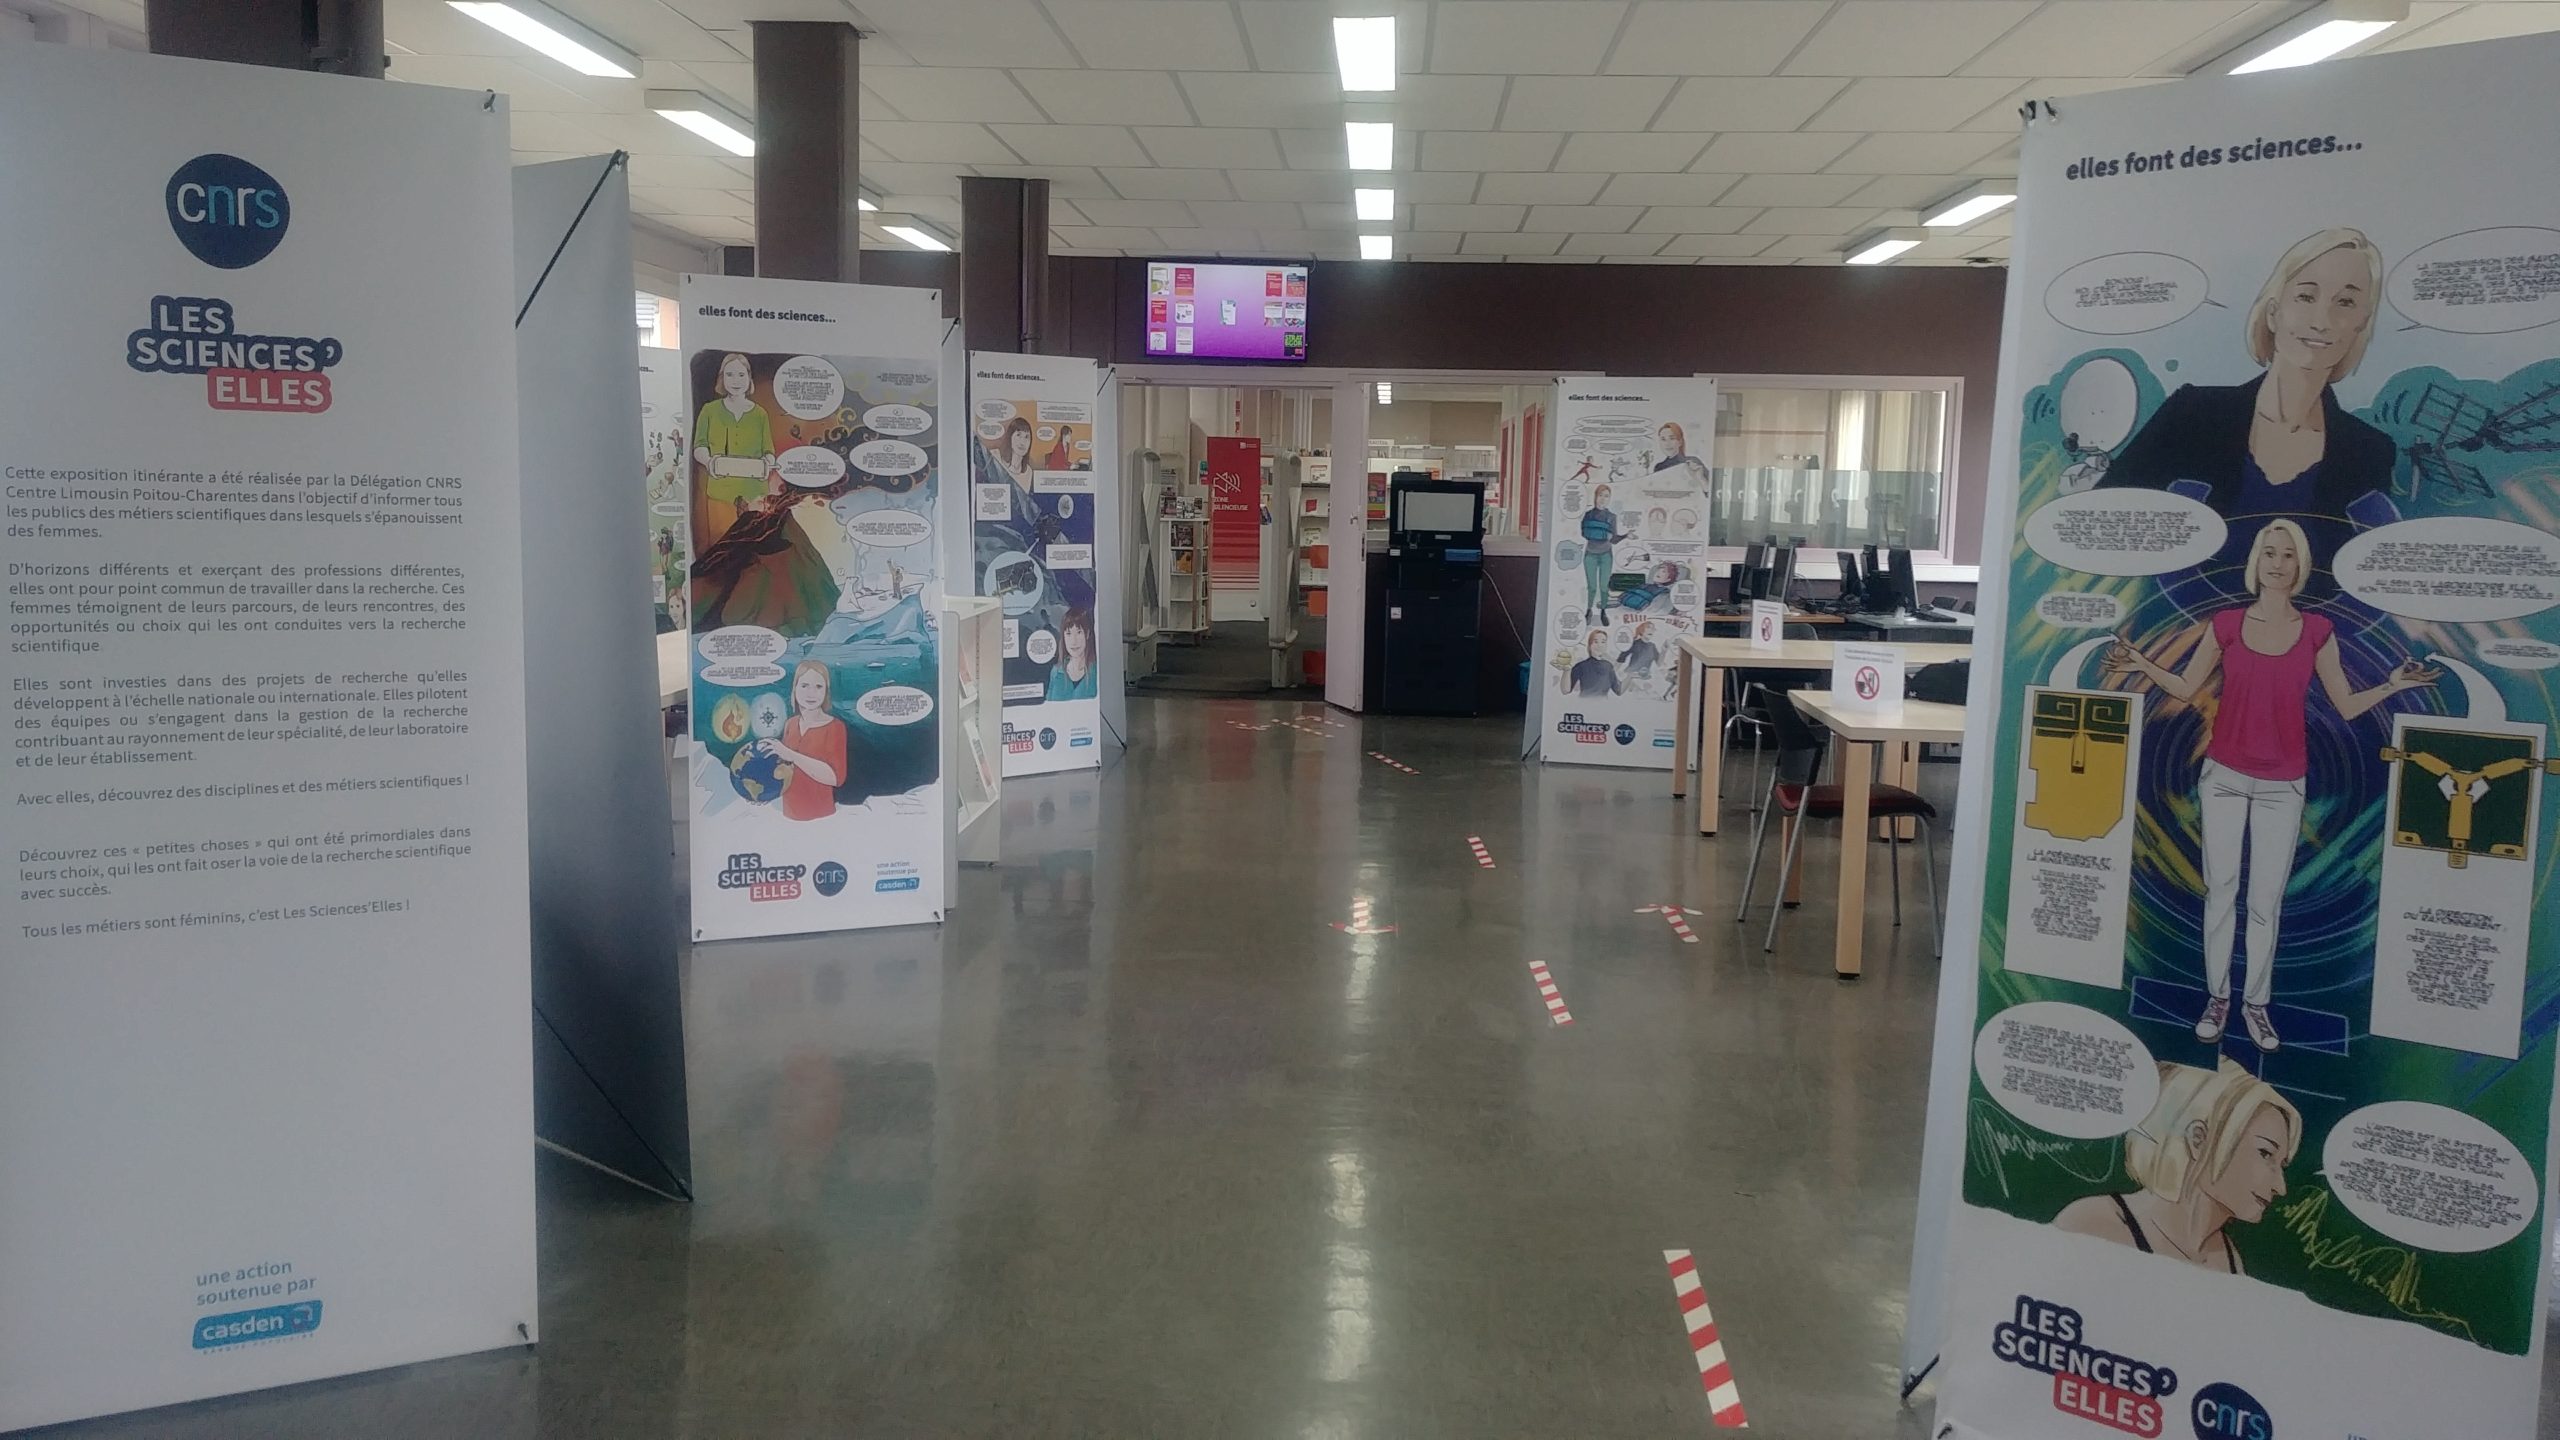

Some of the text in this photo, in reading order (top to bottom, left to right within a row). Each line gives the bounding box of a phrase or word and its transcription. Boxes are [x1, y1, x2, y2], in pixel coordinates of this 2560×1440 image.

[2065, 157, 2119, 181] elles
[2125, 151, 2174, 175] font
[2179, 145, 2222, 169] des
[176, 183, 280, 228] cnrs
[160, 304, 226, 334] LES
[698, 305, 726, 317] elles
[728, 306, 753, 319] font
[755, 308, 776, 320] des
[216, 376, 325, 406] ELLES
[4, 466, 462, 490] Cette exposition itinérante a été réalisée par la Délégation CNRS
[5, 486, 56, 498] Centre
[60, 488, 129, 500] Limousin
[132, 488, 258, 502] Poitou-Charentes
[260, 490, 295, 504] dans
[433, 496, 462, 506] tous
[6, 504, 28, 518] les
[31, 506, 86, 520] publics
[88, 506, 115, 518] des
[118, 506, 173, 520] métiers
[176, 508, 266, 524] scientifiques
[268, 510, 303, 522] dans
[305, 510, 362, 524] lesquels
[6, 524, 34, 538] des
[98, 562, 169, 576] différents
[177, 564, 192, 576] et
[200, 566, 262, 578] exerçant
[270, 564, 295, 576] des
[303, 564, 382, 578] professions
[8, 582, 44, 594] elles
[48, 584, 74, 594] ont
[78, 584, 114, 598] pour
[118, 582, 157, 598] point
[160, 586, 224, 594] commun
[228, 582, 246, 594] de
[249, 582, 312, 594] travailler
[315, 582, 349, 594] dans
[352, 582, 364, 594] la
[441, 582, 465, 594] Ces
[9, 600, 71, 614] femmes
[76, 600, 162, 616] témoignent
[167, 600, 186, 612] de
[190, 600, 226, 612] leurs
[301, 600, 319, 612] de
[324, 600, 358, 612] leurs
[442, 600, 466, 612] des
[1565, 714, 1583, 723] LES
[1010, 742, 1033, 752] ELLES
[1577, 733, 1606, 742] ELLES
[15, 792, 53, 806] Avec
[97, 788, 173, 802] découvrez
[175, 786, 202, 798] des
[204, 784, 279, 798] disciplines
[281, 782, 296, 794] et
[298, 780, 322, 792] des
[325, 778, 377, 792] métiers
[378, 776, 462, 790] scientifiques
[19, 848, 97, 862] Découvrez
[102, 848, 127, 858] ces
[145, 842, 195, 858] petites
[200, 840, 249, 852] choses
[266, 836, 289, 850] qui
[294, 836, 318, 846] ont
[322, 832, 345, 844] été
[350, 828, 434, 848] primordiales
[439, 826, 471, 838] dans
[19, 868, 56, 880] leurs
[106, 862, 130, 878] qui
[133, 862, 154, 874] les
[156, 860, 182, 872] ont
[184, 858, 208, 872] fait
[210, 858, 241, 870] oser
[243, 856, 256, 868] la
[258, 854, 288, 866] voie
[290, 852, 308, 864] de
[310, 852, 323, 864] la
[326, 848, 393, 862] recherche
[394, 844, 471, 858] scientifique
[731, 856, 759, 871] LES
[816, 870, 846, 883] cnrs
[20, 890, 55, 900] avec
[753, 884, 799, 900] ELLES
[21, 924, 58, 938] Tous
[60, 922, 82, 936] les
[85, 918, 141, 934] métiers
[144, 916, 176, 928] sont
[282, 908, 306, 920] Les
[196, 1261, 292, 1287] une action
[196, 1277, 317, 1306] soutenue par
[202, 1315, 284, 1341] casden
[2021, 1303, 2076, 1342] LES
[2060, 1380, 2155, 1433] ELLES
[2197, 1398, 2266, 1439] cnrs
